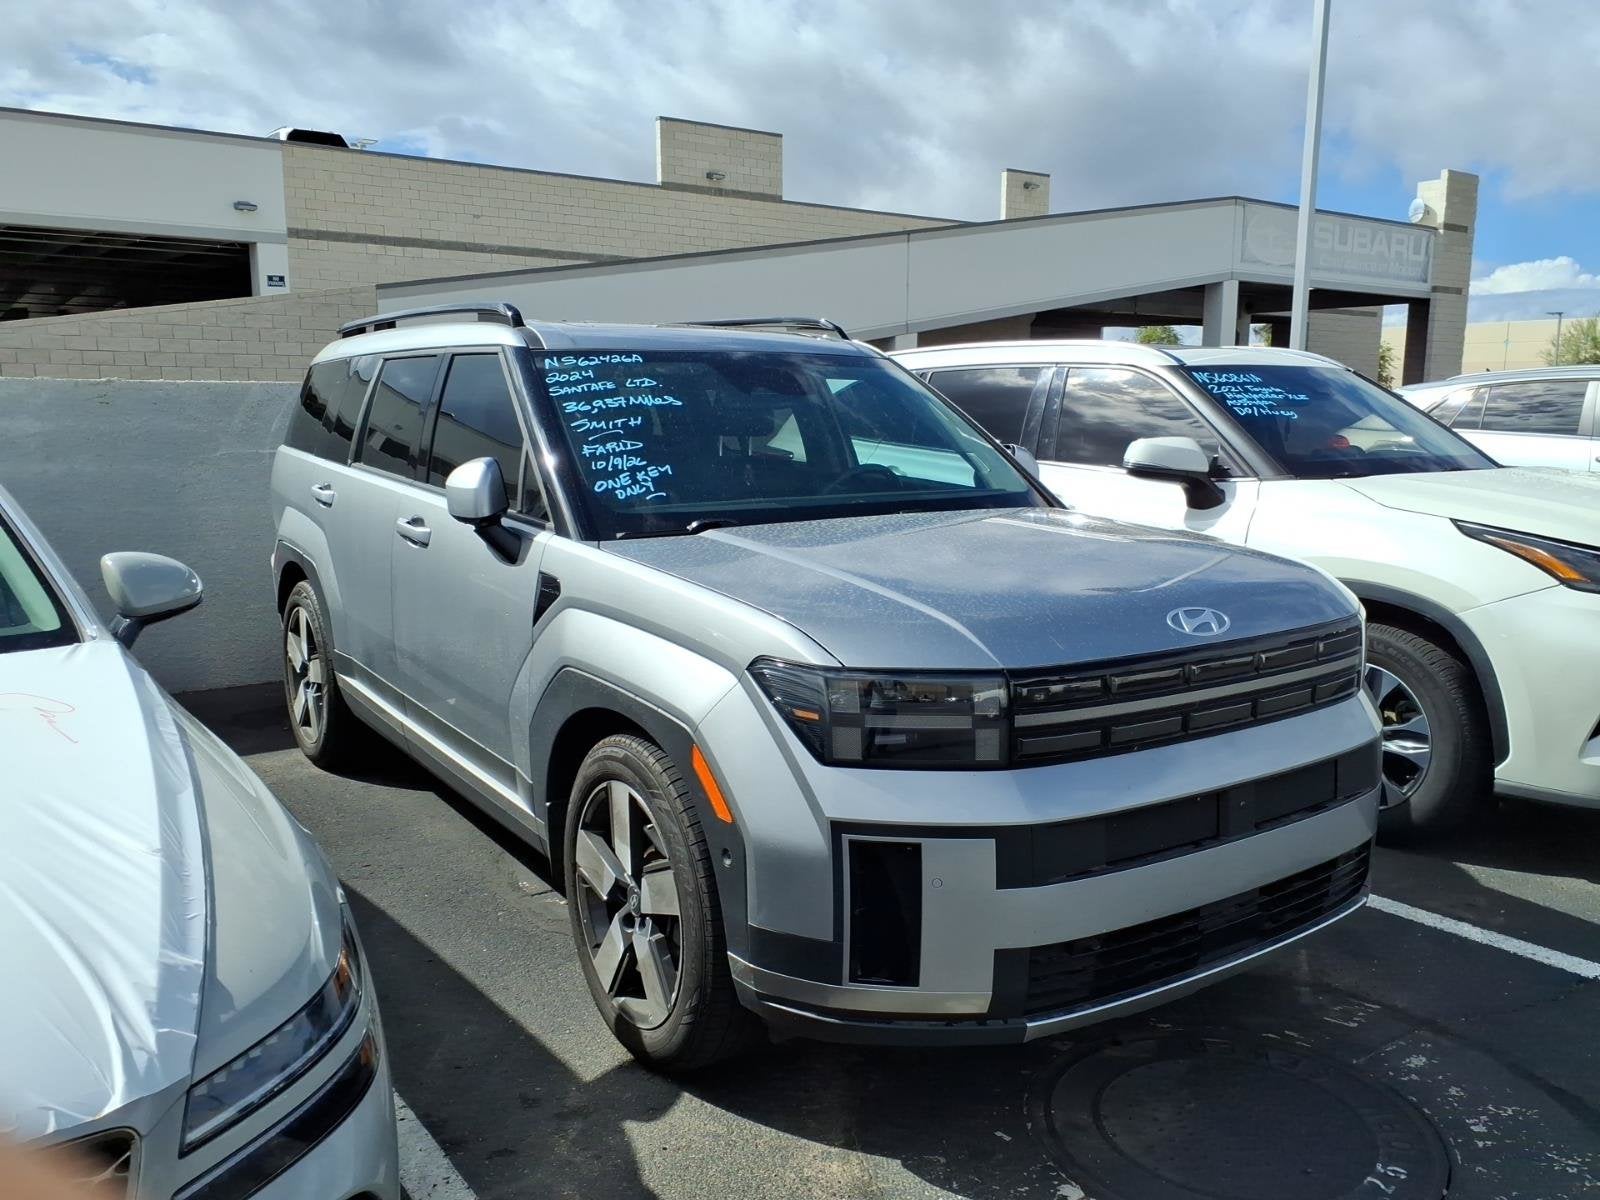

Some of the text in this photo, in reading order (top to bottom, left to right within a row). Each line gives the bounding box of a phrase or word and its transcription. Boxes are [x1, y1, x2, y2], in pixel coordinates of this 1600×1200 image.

[1312, 221, 1427, 262] SUBARU
[545, 369, 594, 383] 2024
[1208, 384, 1244, 394] 2021
[570, 416, 642, 432] SMITH
[594, 464, 673, 492] ONE KEY
[614, 481, 655, 500] ONLY
